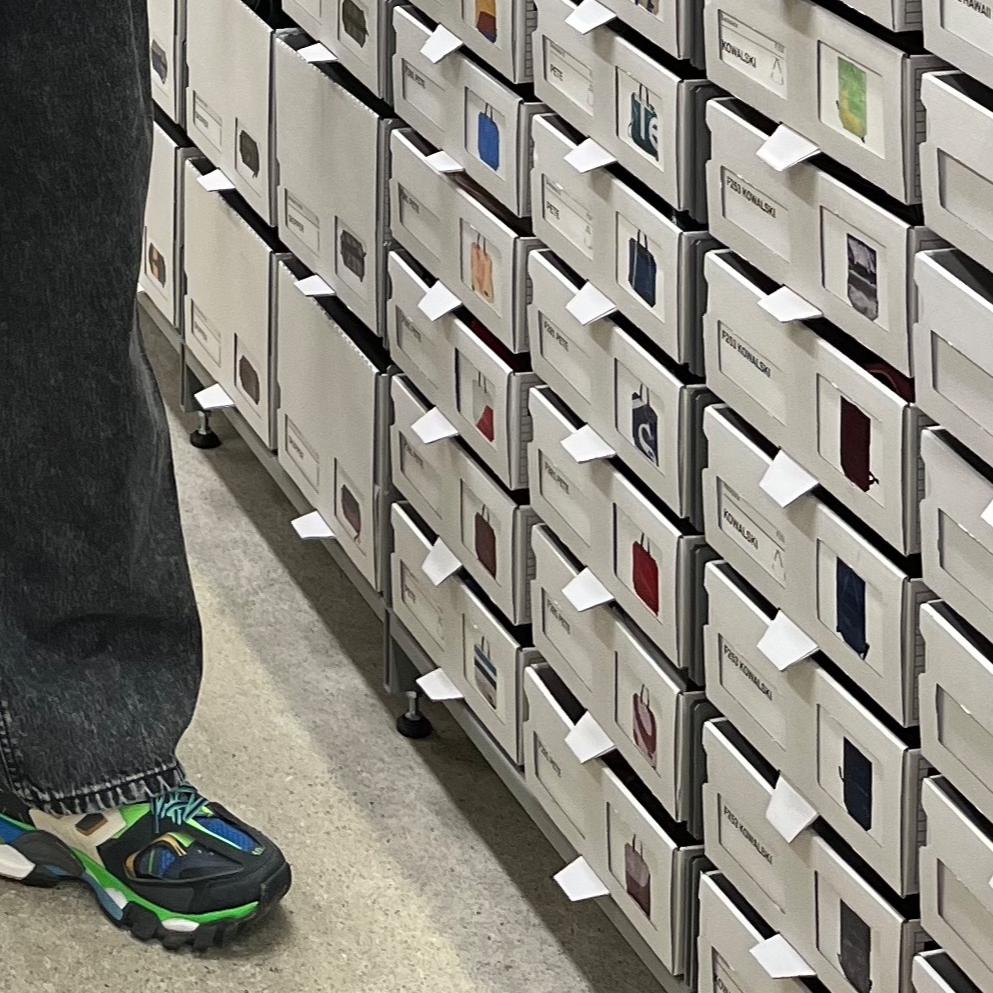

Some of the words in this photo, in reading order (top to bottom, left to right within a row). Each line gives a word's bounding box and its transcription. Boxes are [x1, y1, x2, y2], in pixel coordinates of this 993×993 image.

[720, 38, 756, 69] KOWALSKI
[742, 185, 777, 219] KOWALSKI
[737, 342, 771, 378] KOWALSKI
[723, 507, 759, 550] KOWALSKI
[739, 660, 773, 702] KOWALSKI
[739, 823, 773, 865] KOWALSKI
